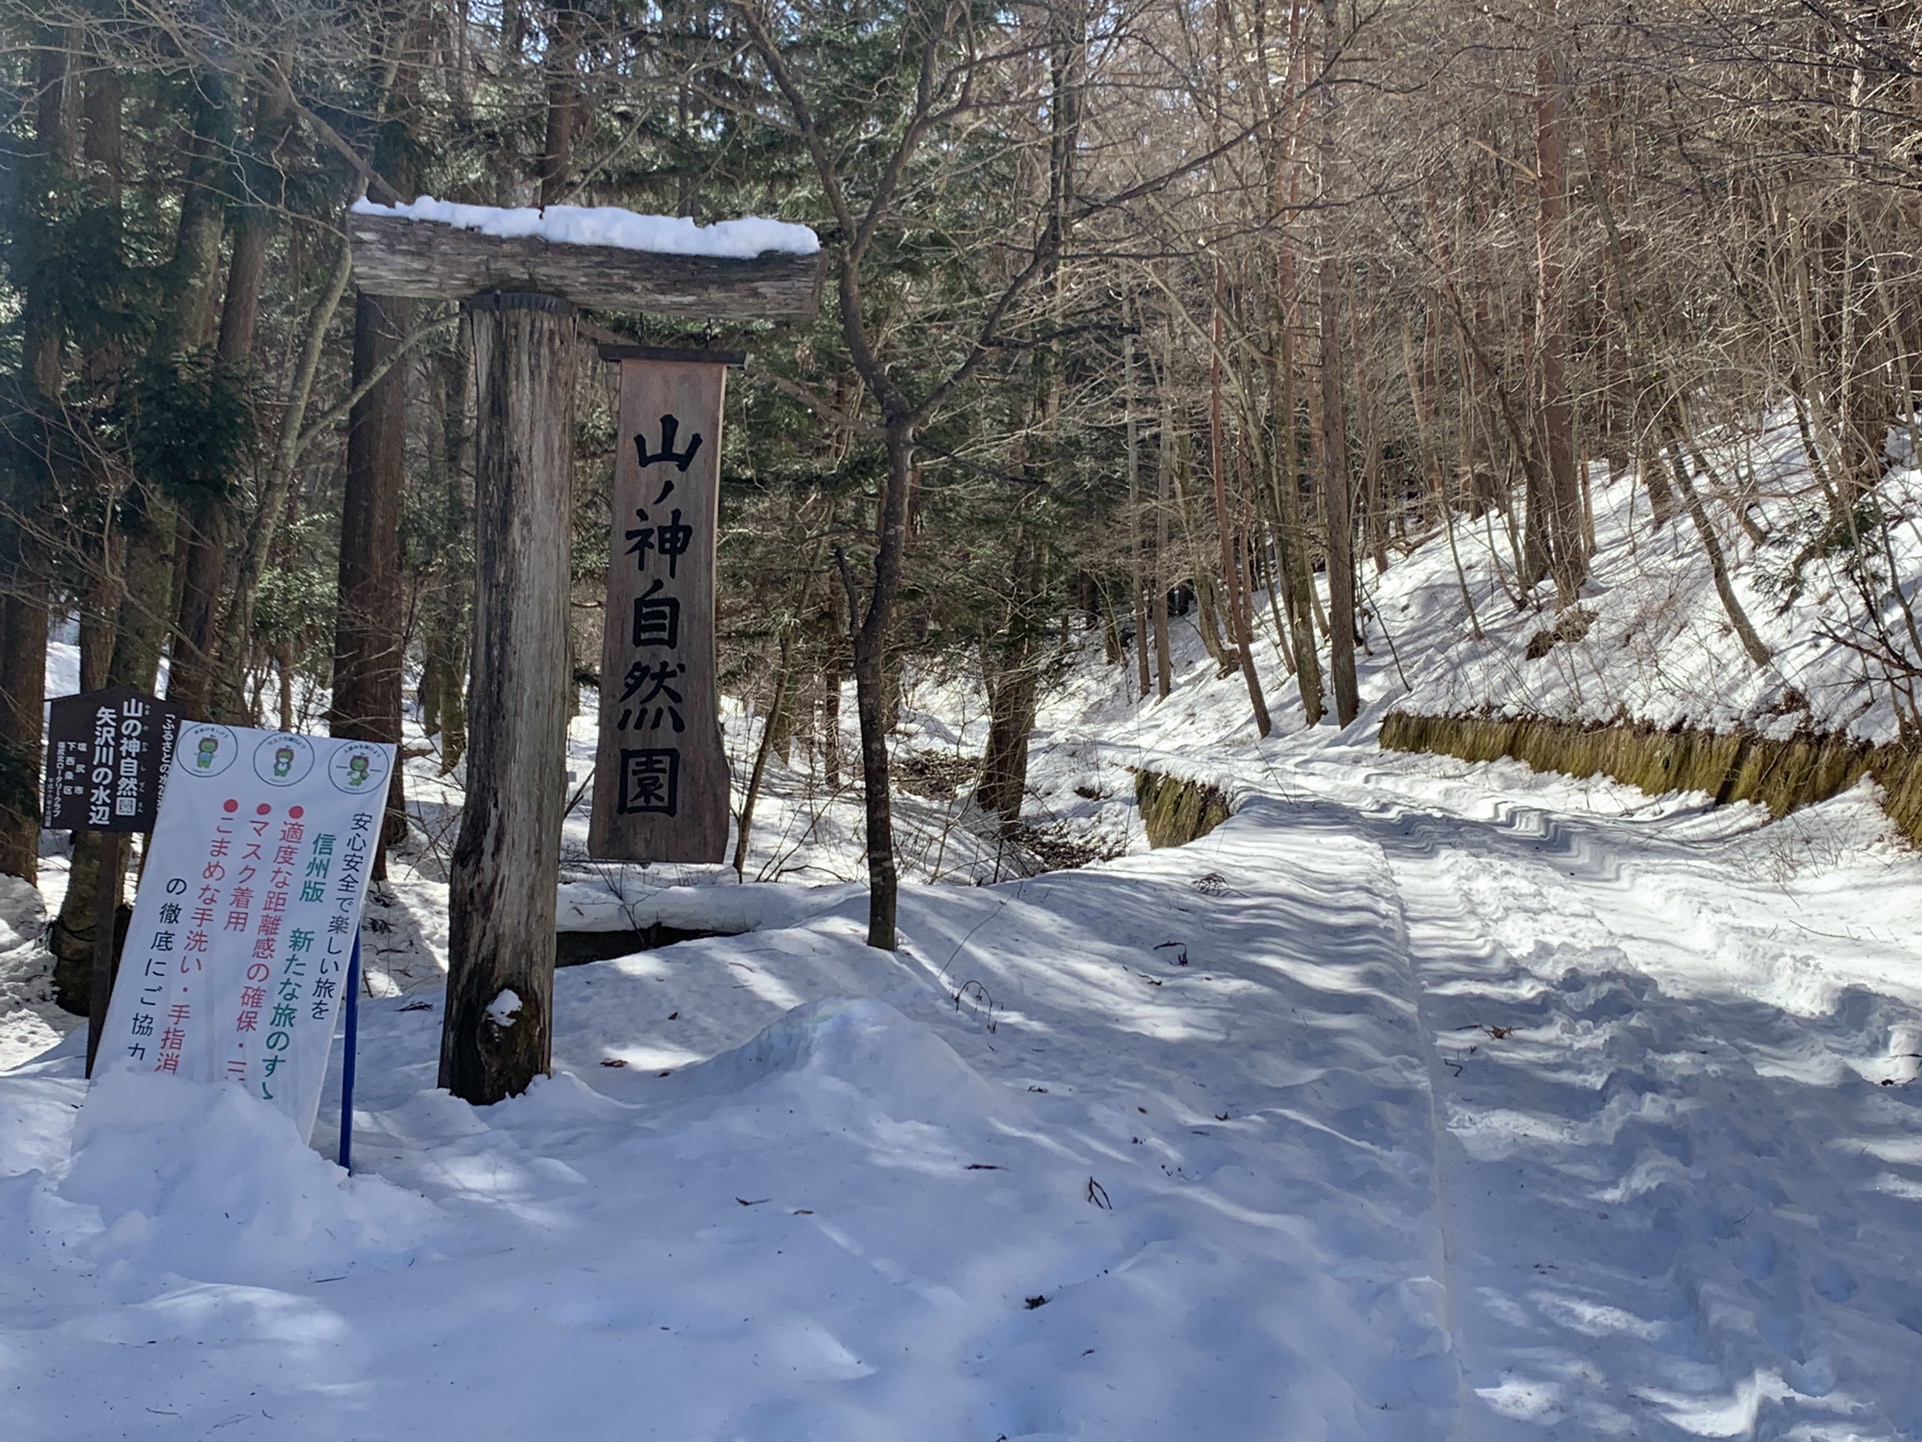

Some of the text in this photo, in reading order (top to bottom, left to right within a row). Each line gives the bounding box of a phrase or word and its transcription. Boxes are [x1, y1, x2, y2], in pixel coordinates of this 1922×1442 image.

[617, 413, 703, 818] 山ノ神自然園
[88, 706, 118, 826] 矢沢川の水辺
[115, 698, 144, 817] 山の神自然園
[223, 819, 270, 933] マスク着用
[299, 832, 337, 904] 信州版
[311, 812, 373, 1021] 安心安全で楽しい旅を
[128, 877, 187, 1061] の徹底にご協力
